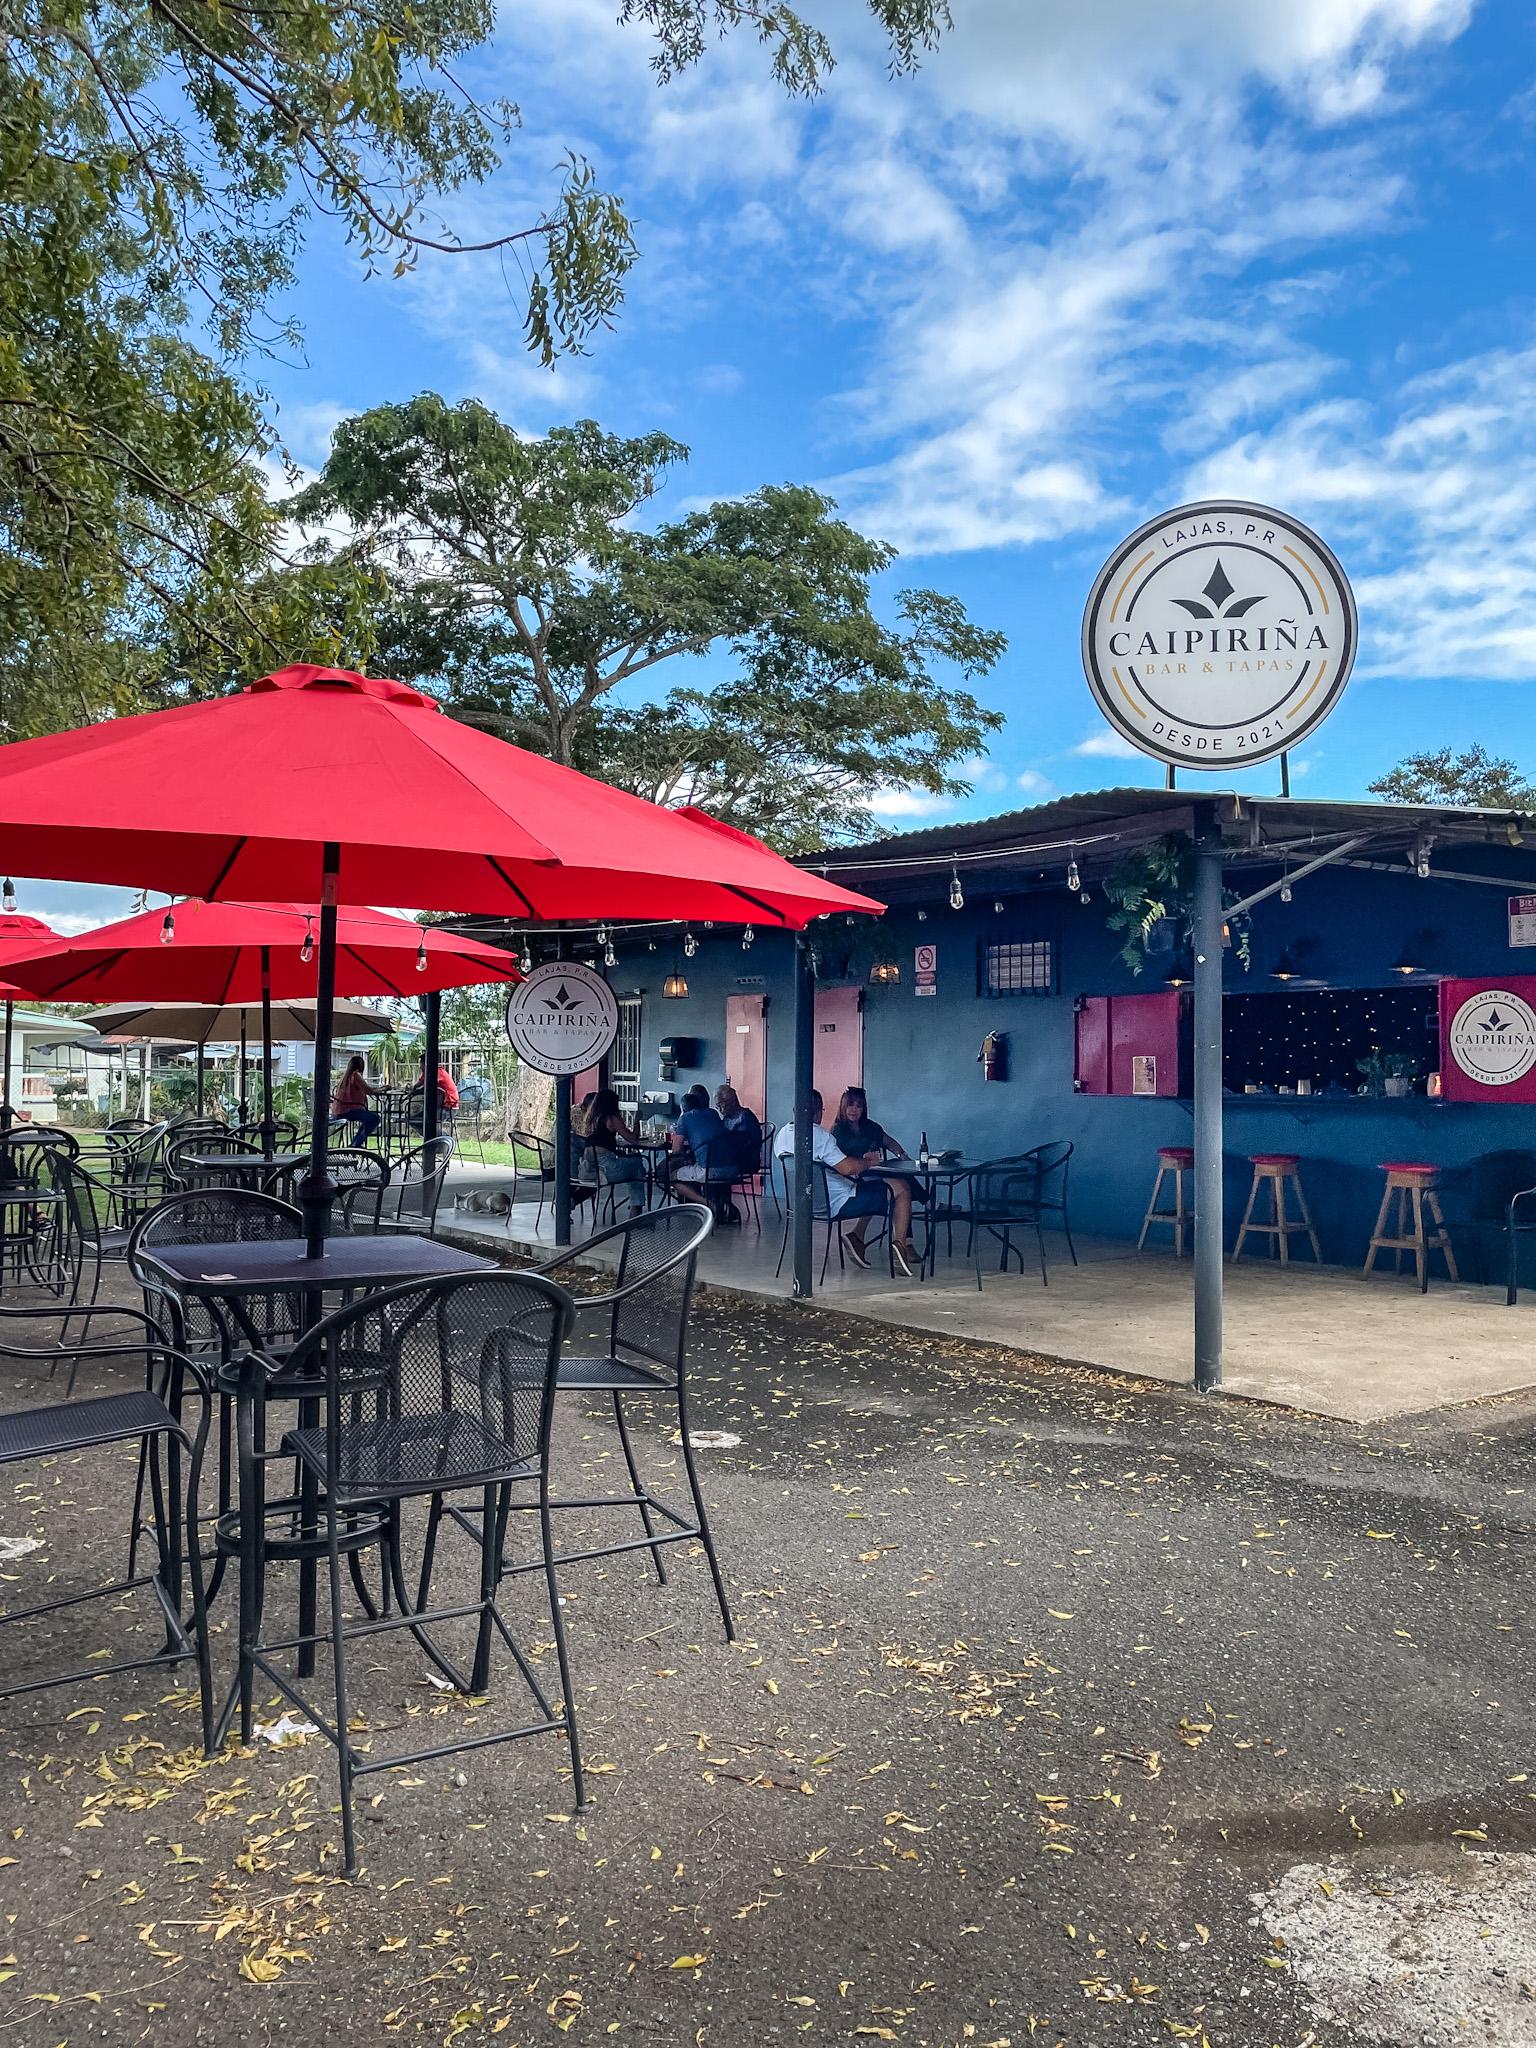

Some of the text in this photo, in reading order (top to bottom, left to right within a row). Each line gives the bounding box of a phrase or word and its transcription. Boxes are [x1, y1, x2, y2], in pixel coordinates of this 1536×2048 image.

[1162, 521, 1276, 548] LAJAS, P.R
[1108, 618, 1329, 657] CAIPIRIÑA
[1146, 659, 1294, 675] BAR & TAPAS
[1152, 719, 1284, 750] DESDE 2021
[513, 1012, 611, 1027] CAIPIRIÑA
[1455, 1033, 1535, 1045] CAIPIRIÑA
[531, 1055, 590, 1070] DESDE 2021
[1470, 1069, 1496, 1082] DESDE
